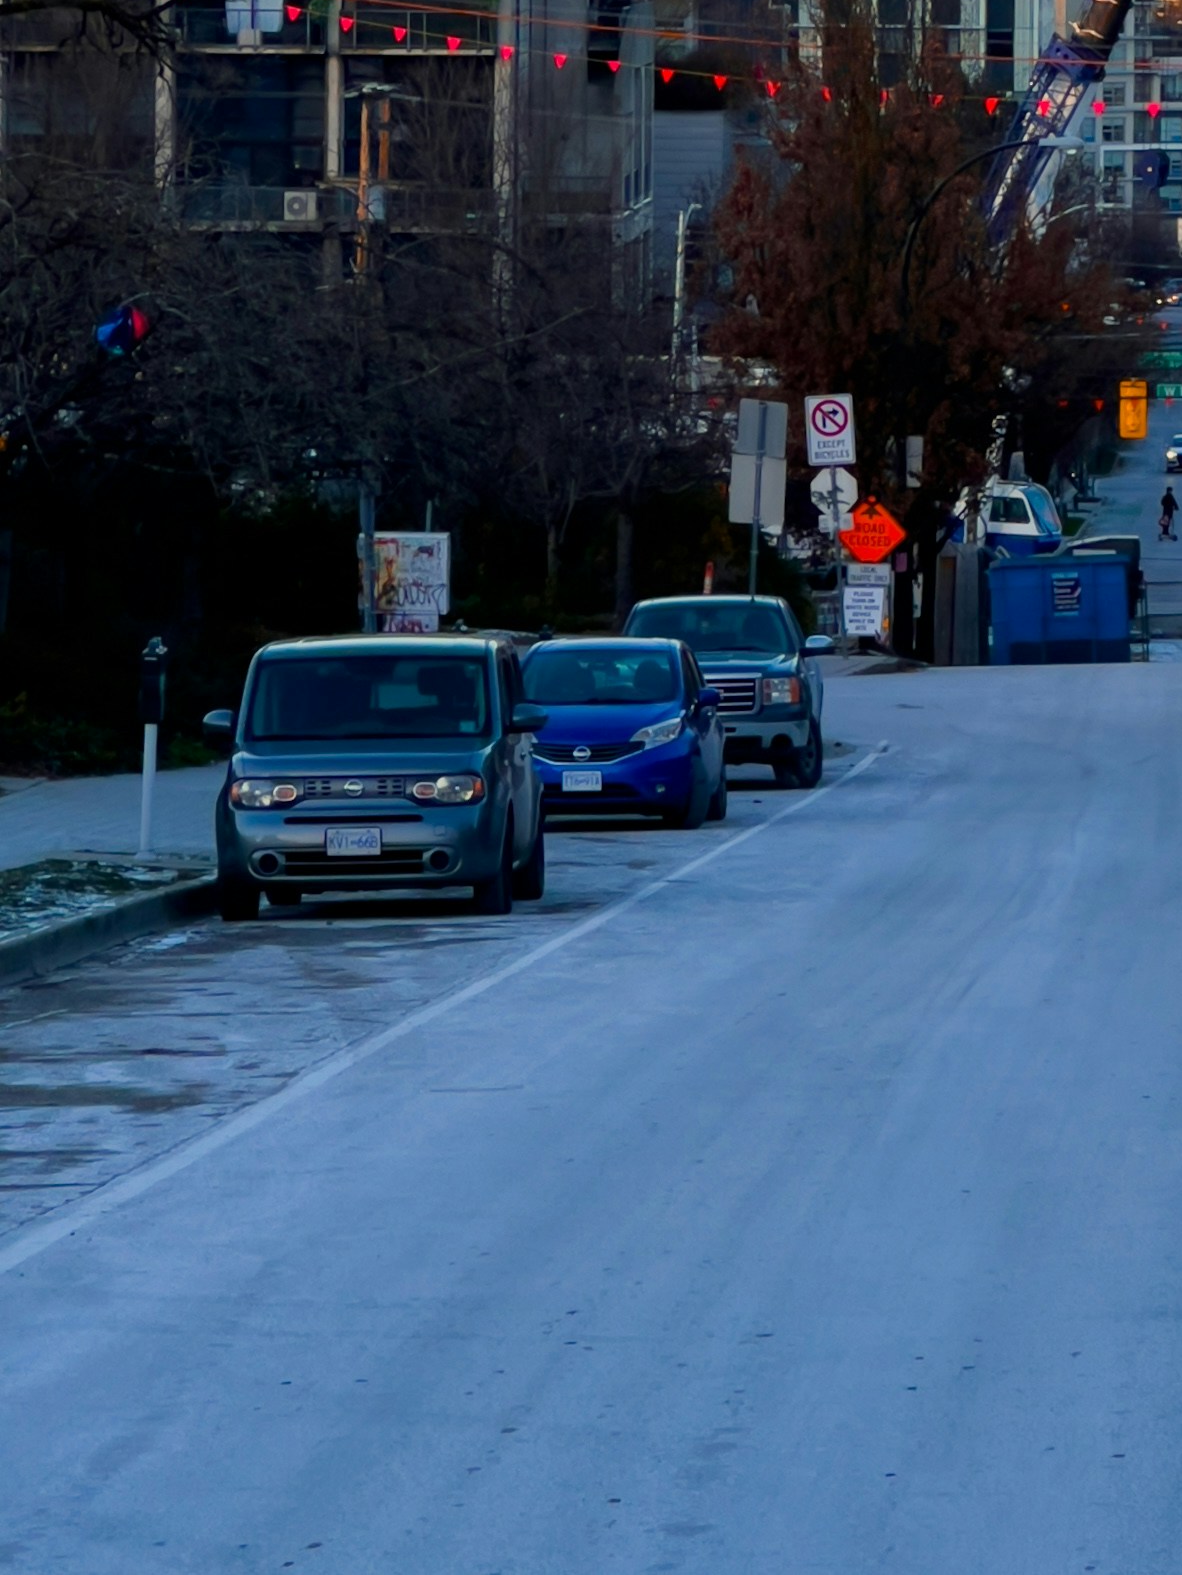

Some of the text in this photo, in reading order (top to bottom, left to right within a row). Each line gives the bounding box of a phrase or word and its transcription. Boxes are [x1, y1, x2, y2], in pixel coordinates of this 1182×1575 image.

[1164, 387, 1176, 396] W
[817, 439, 845, 449] EXCEPT
[814, 449, 850, 460] BICYCLES
[854, 522, 886, 534] ROAD
[848, 535, 891, 548] CLOSED
